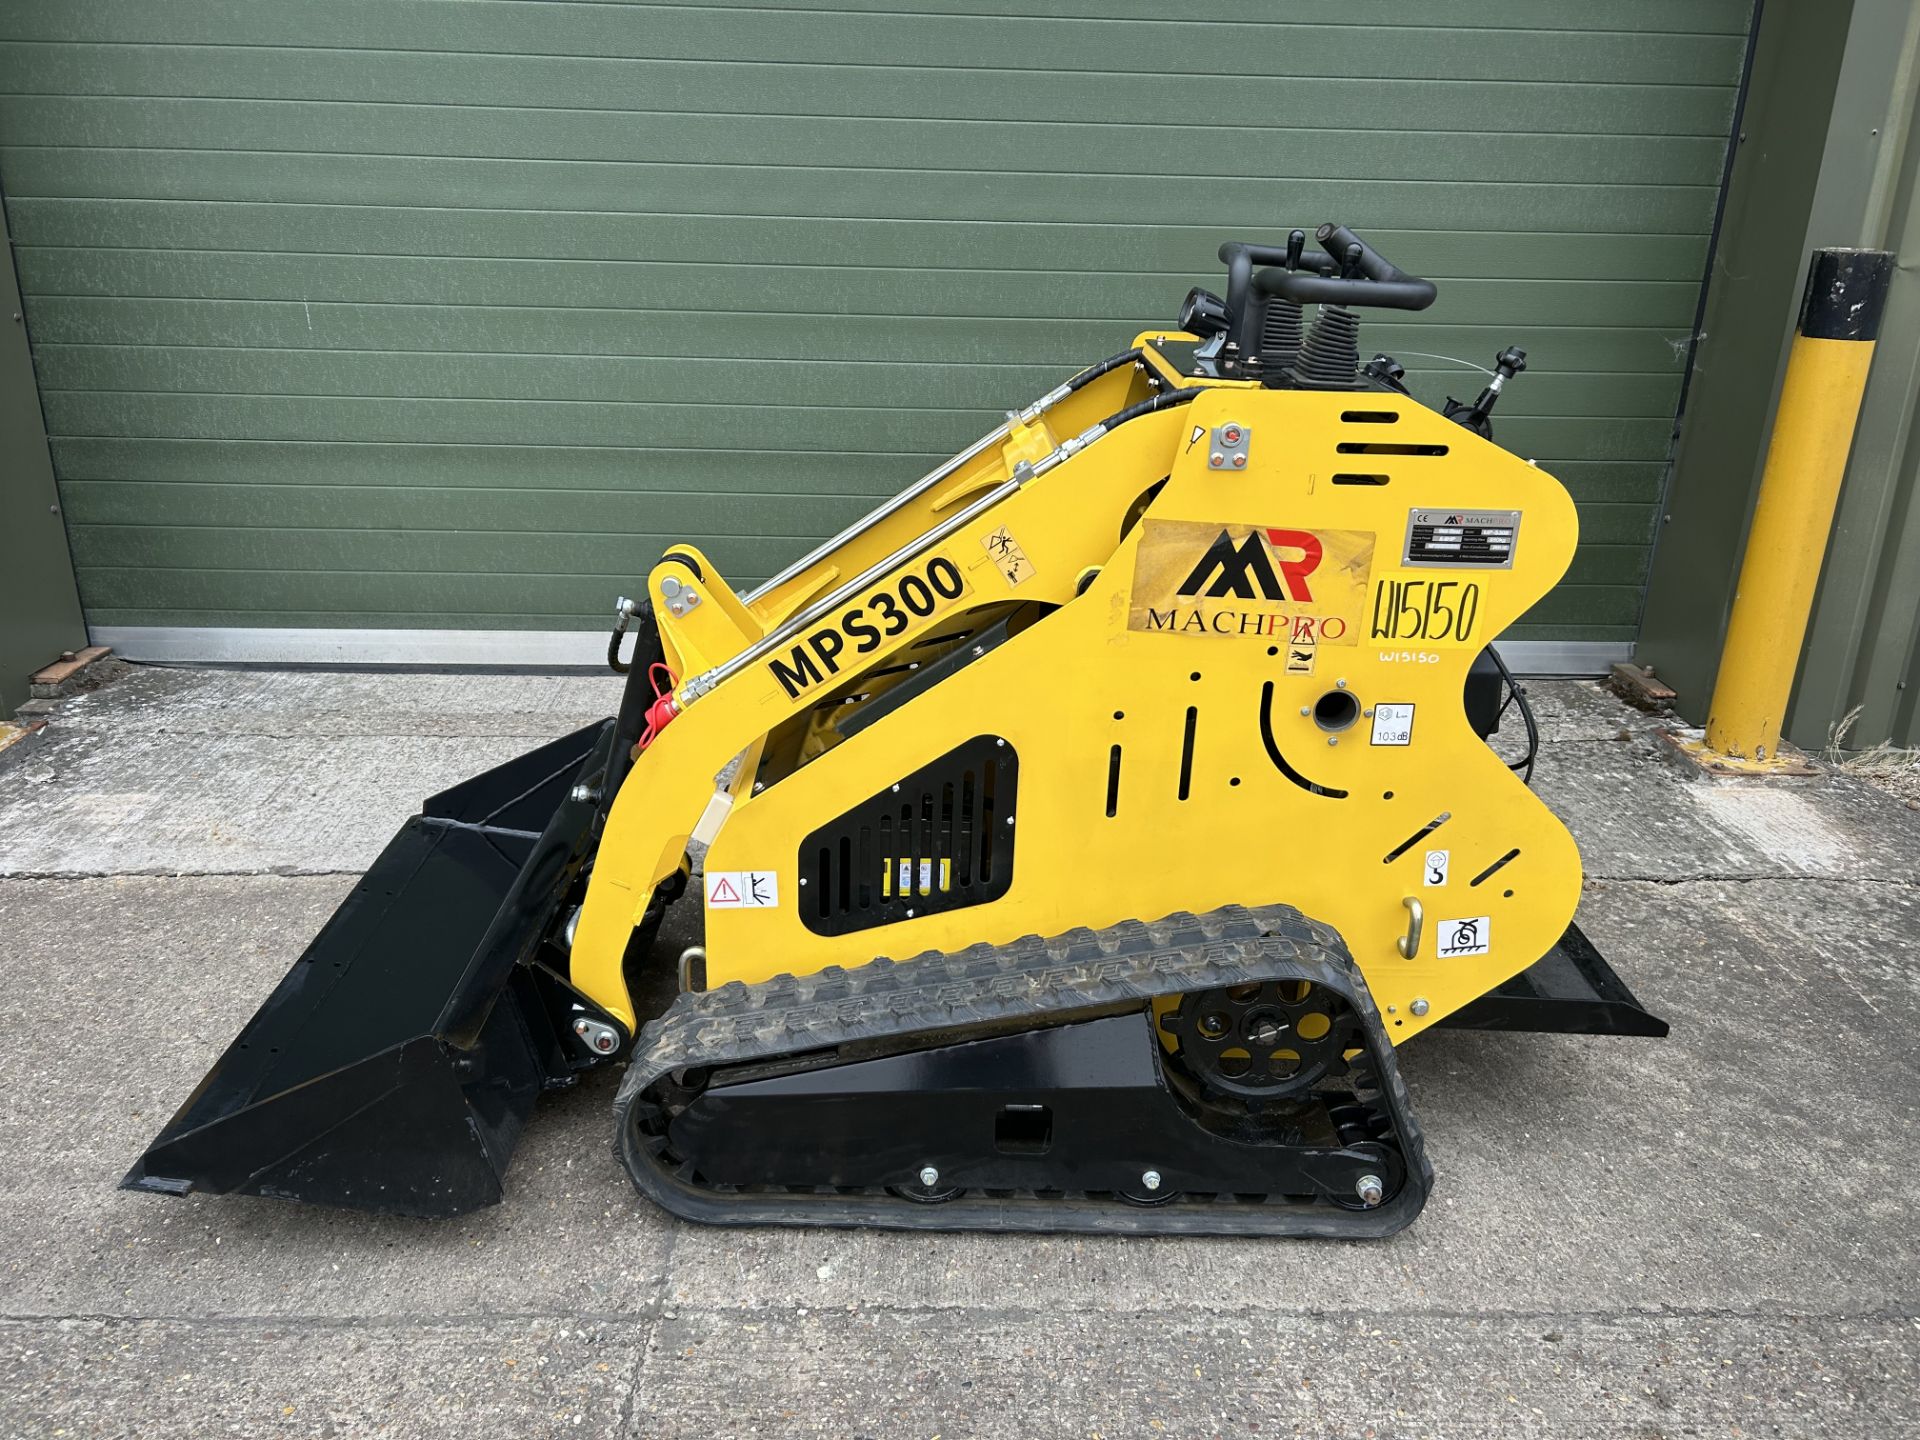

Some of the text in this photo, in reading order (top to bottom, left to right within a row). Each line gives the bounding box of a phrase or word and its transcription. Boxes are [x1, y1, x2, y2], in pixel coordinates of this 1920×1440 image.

[1417, 514, 1429, 522] CE
[1145, 607, 1347, 639] MACHPRO
[1371, 579, 1480, 642] W15150
[768, 557, 964, 699] MPS300
[1379, 651, 1440, 665] W15150
